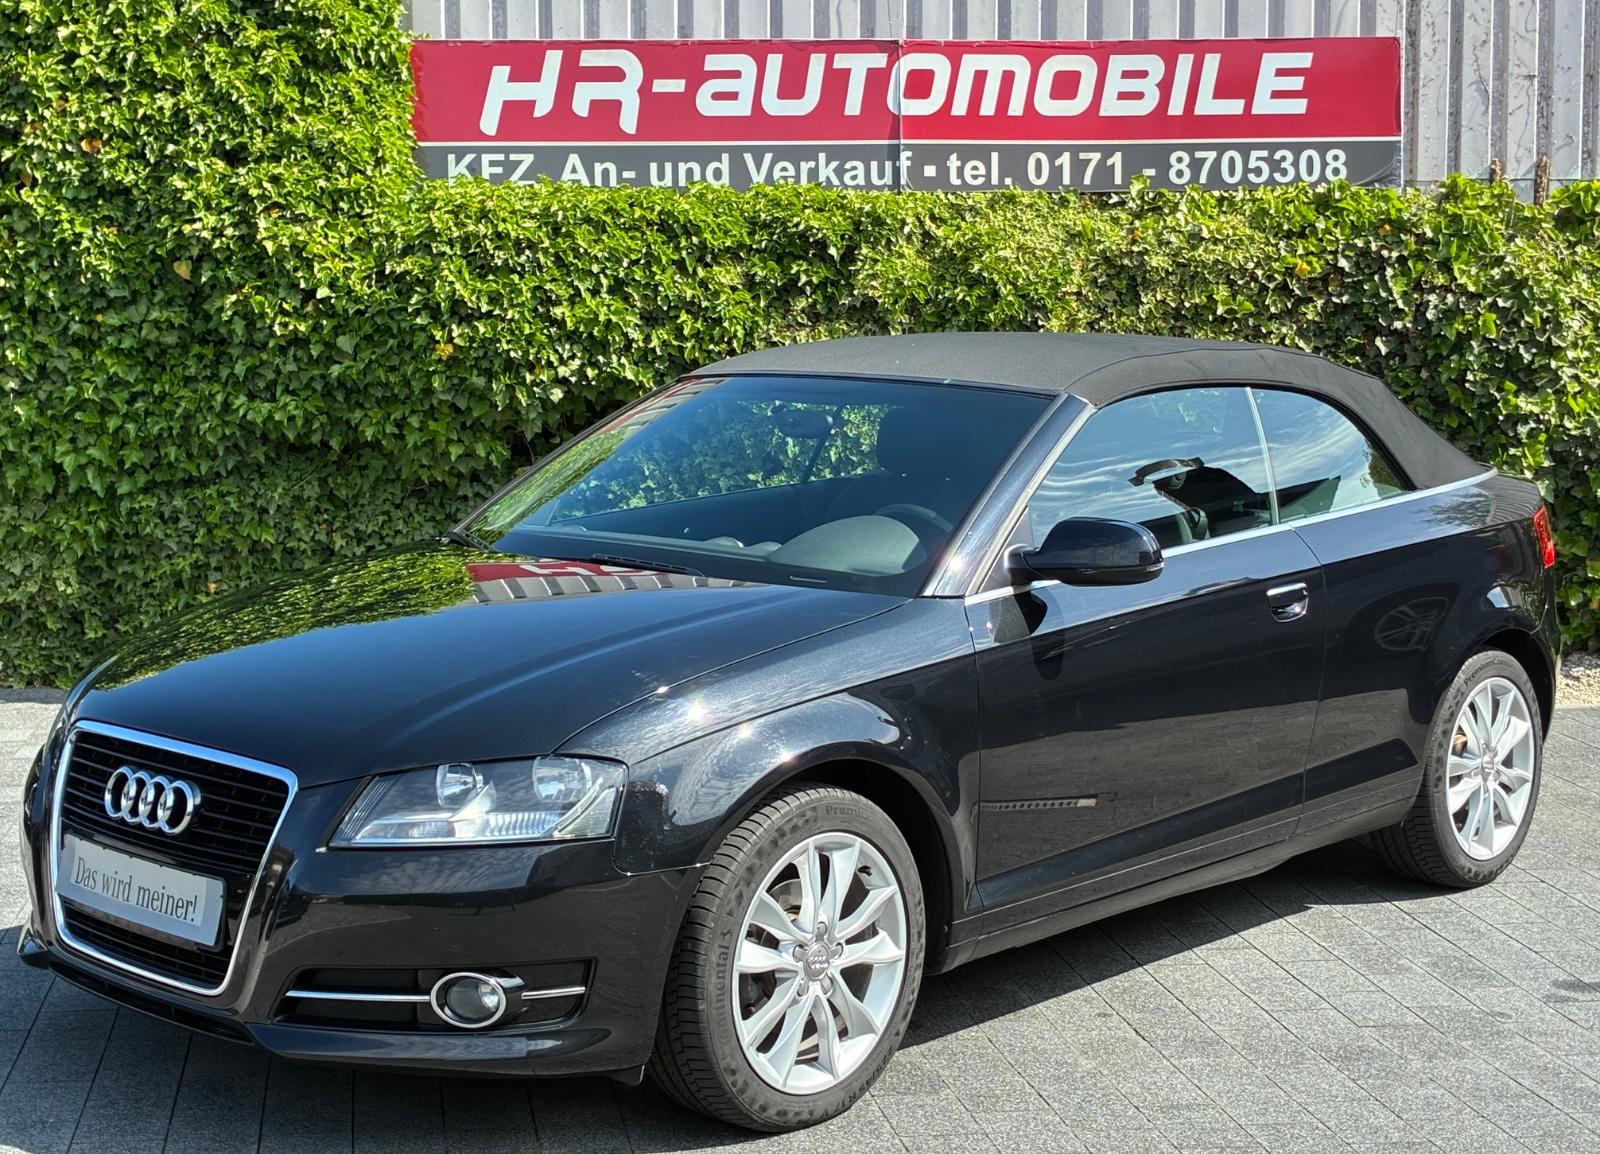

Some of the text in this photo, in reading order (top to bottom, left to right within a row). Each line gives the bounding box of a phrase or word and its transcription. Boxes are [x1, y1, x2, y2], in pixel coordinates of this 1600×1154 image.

[560, 153, 636, 187] An-
[649, 152, 730, 187] und
[743, 151, 912, 187] Verkauf
[947, 152, 1012, 185] tel.
[1027, 151, 1122, 185] 0171
[1168, 149, 1347, 184] 8705308
[75, 857, 198, 922] Das wird meiner!
